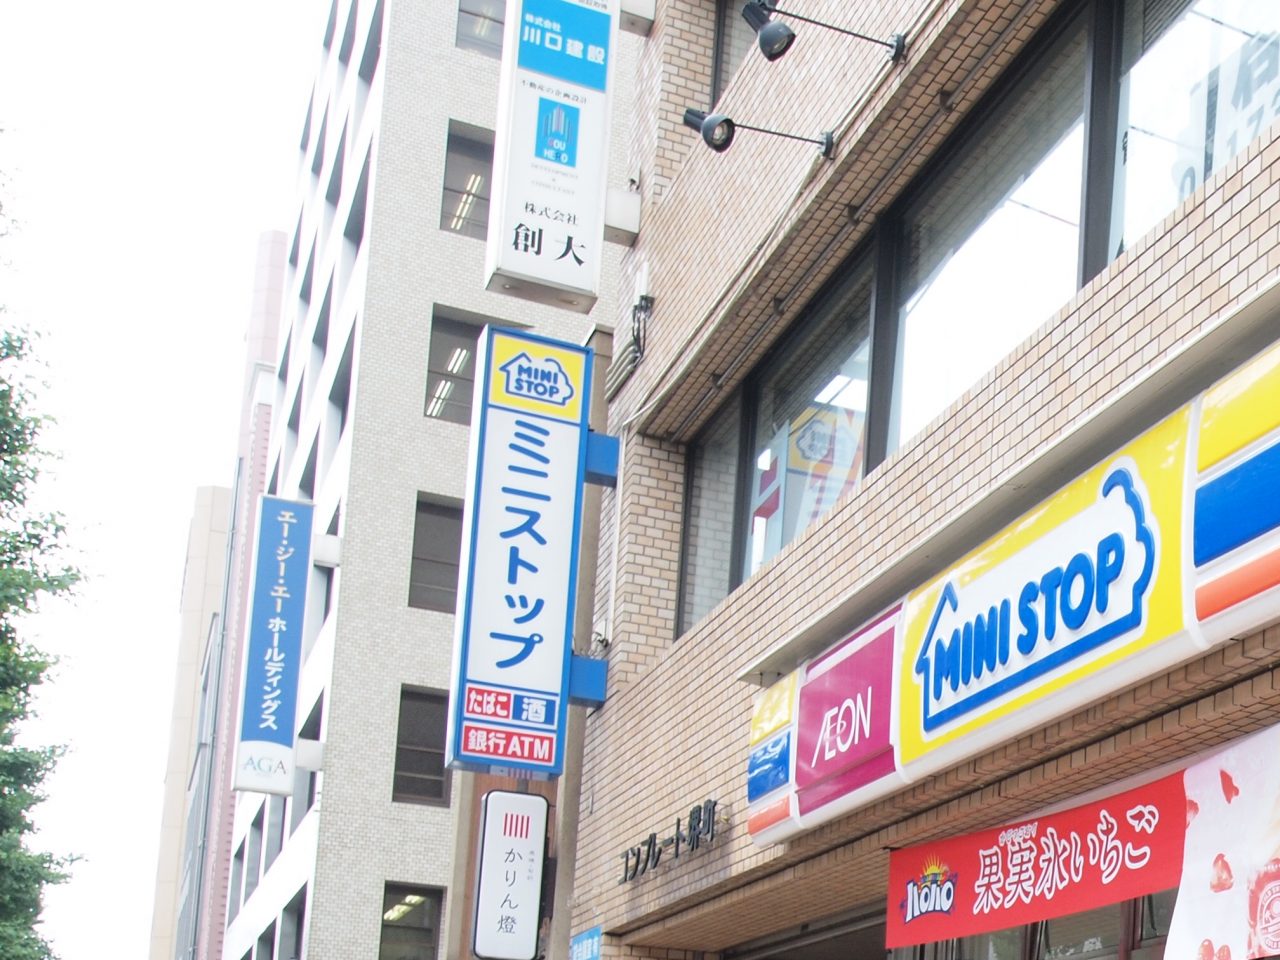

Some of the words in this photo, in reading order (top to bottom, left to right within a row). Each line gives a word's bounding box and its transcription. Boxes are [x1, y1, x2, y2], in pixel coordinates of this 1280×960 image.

[522, 25, 606, 65] 川口建設
[523, 201, 578, 226] 株式会社
[514, 379, 560, 398] STOP
[517, 363, 560, 383] MINI
[489, 419, 551, 669] ミニストップ
[933, 596, 1011, 702] MINI
[1017, 531, 1126, 657] STOP
[258, 617, 288, 731] ホールディングス
[468, 689, 509, 717] たばこ
[521, 697, 546, 724] 酒
[467, 728, 550, 760] 銀行ATM
[243, 752, 287, 775] AGA
[973, 803, 1160, 916] 果実氷いちご
[497, 848, 523, 935] かりん燈
